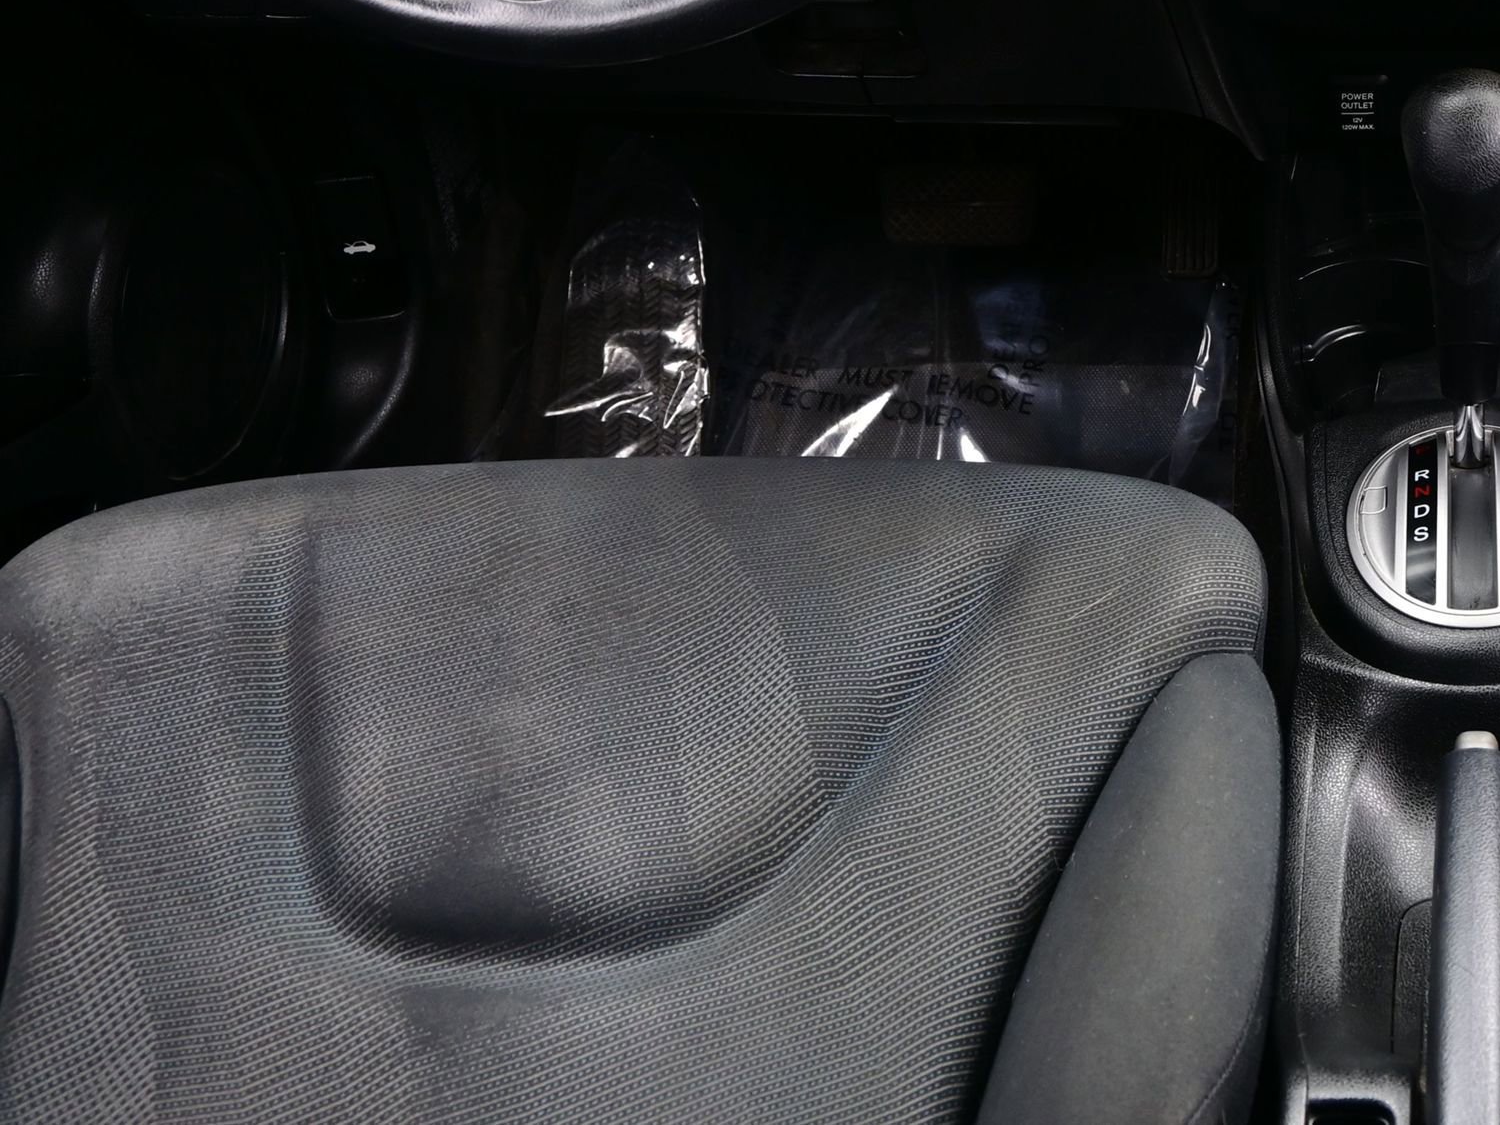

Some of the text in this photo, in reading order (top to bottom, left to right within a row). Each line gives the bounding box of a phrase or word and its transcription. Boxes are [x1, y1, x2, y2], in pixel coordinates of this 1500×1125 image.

[838, 366, 913, 387] MUST
[883, 396, 962, 426] COVER
[1414, 469, 1430, 482] R
[1415, 485, 1430, 498] N
[1414, 504, 1430, 519] D
[1413, 526, 1429, 542] S
